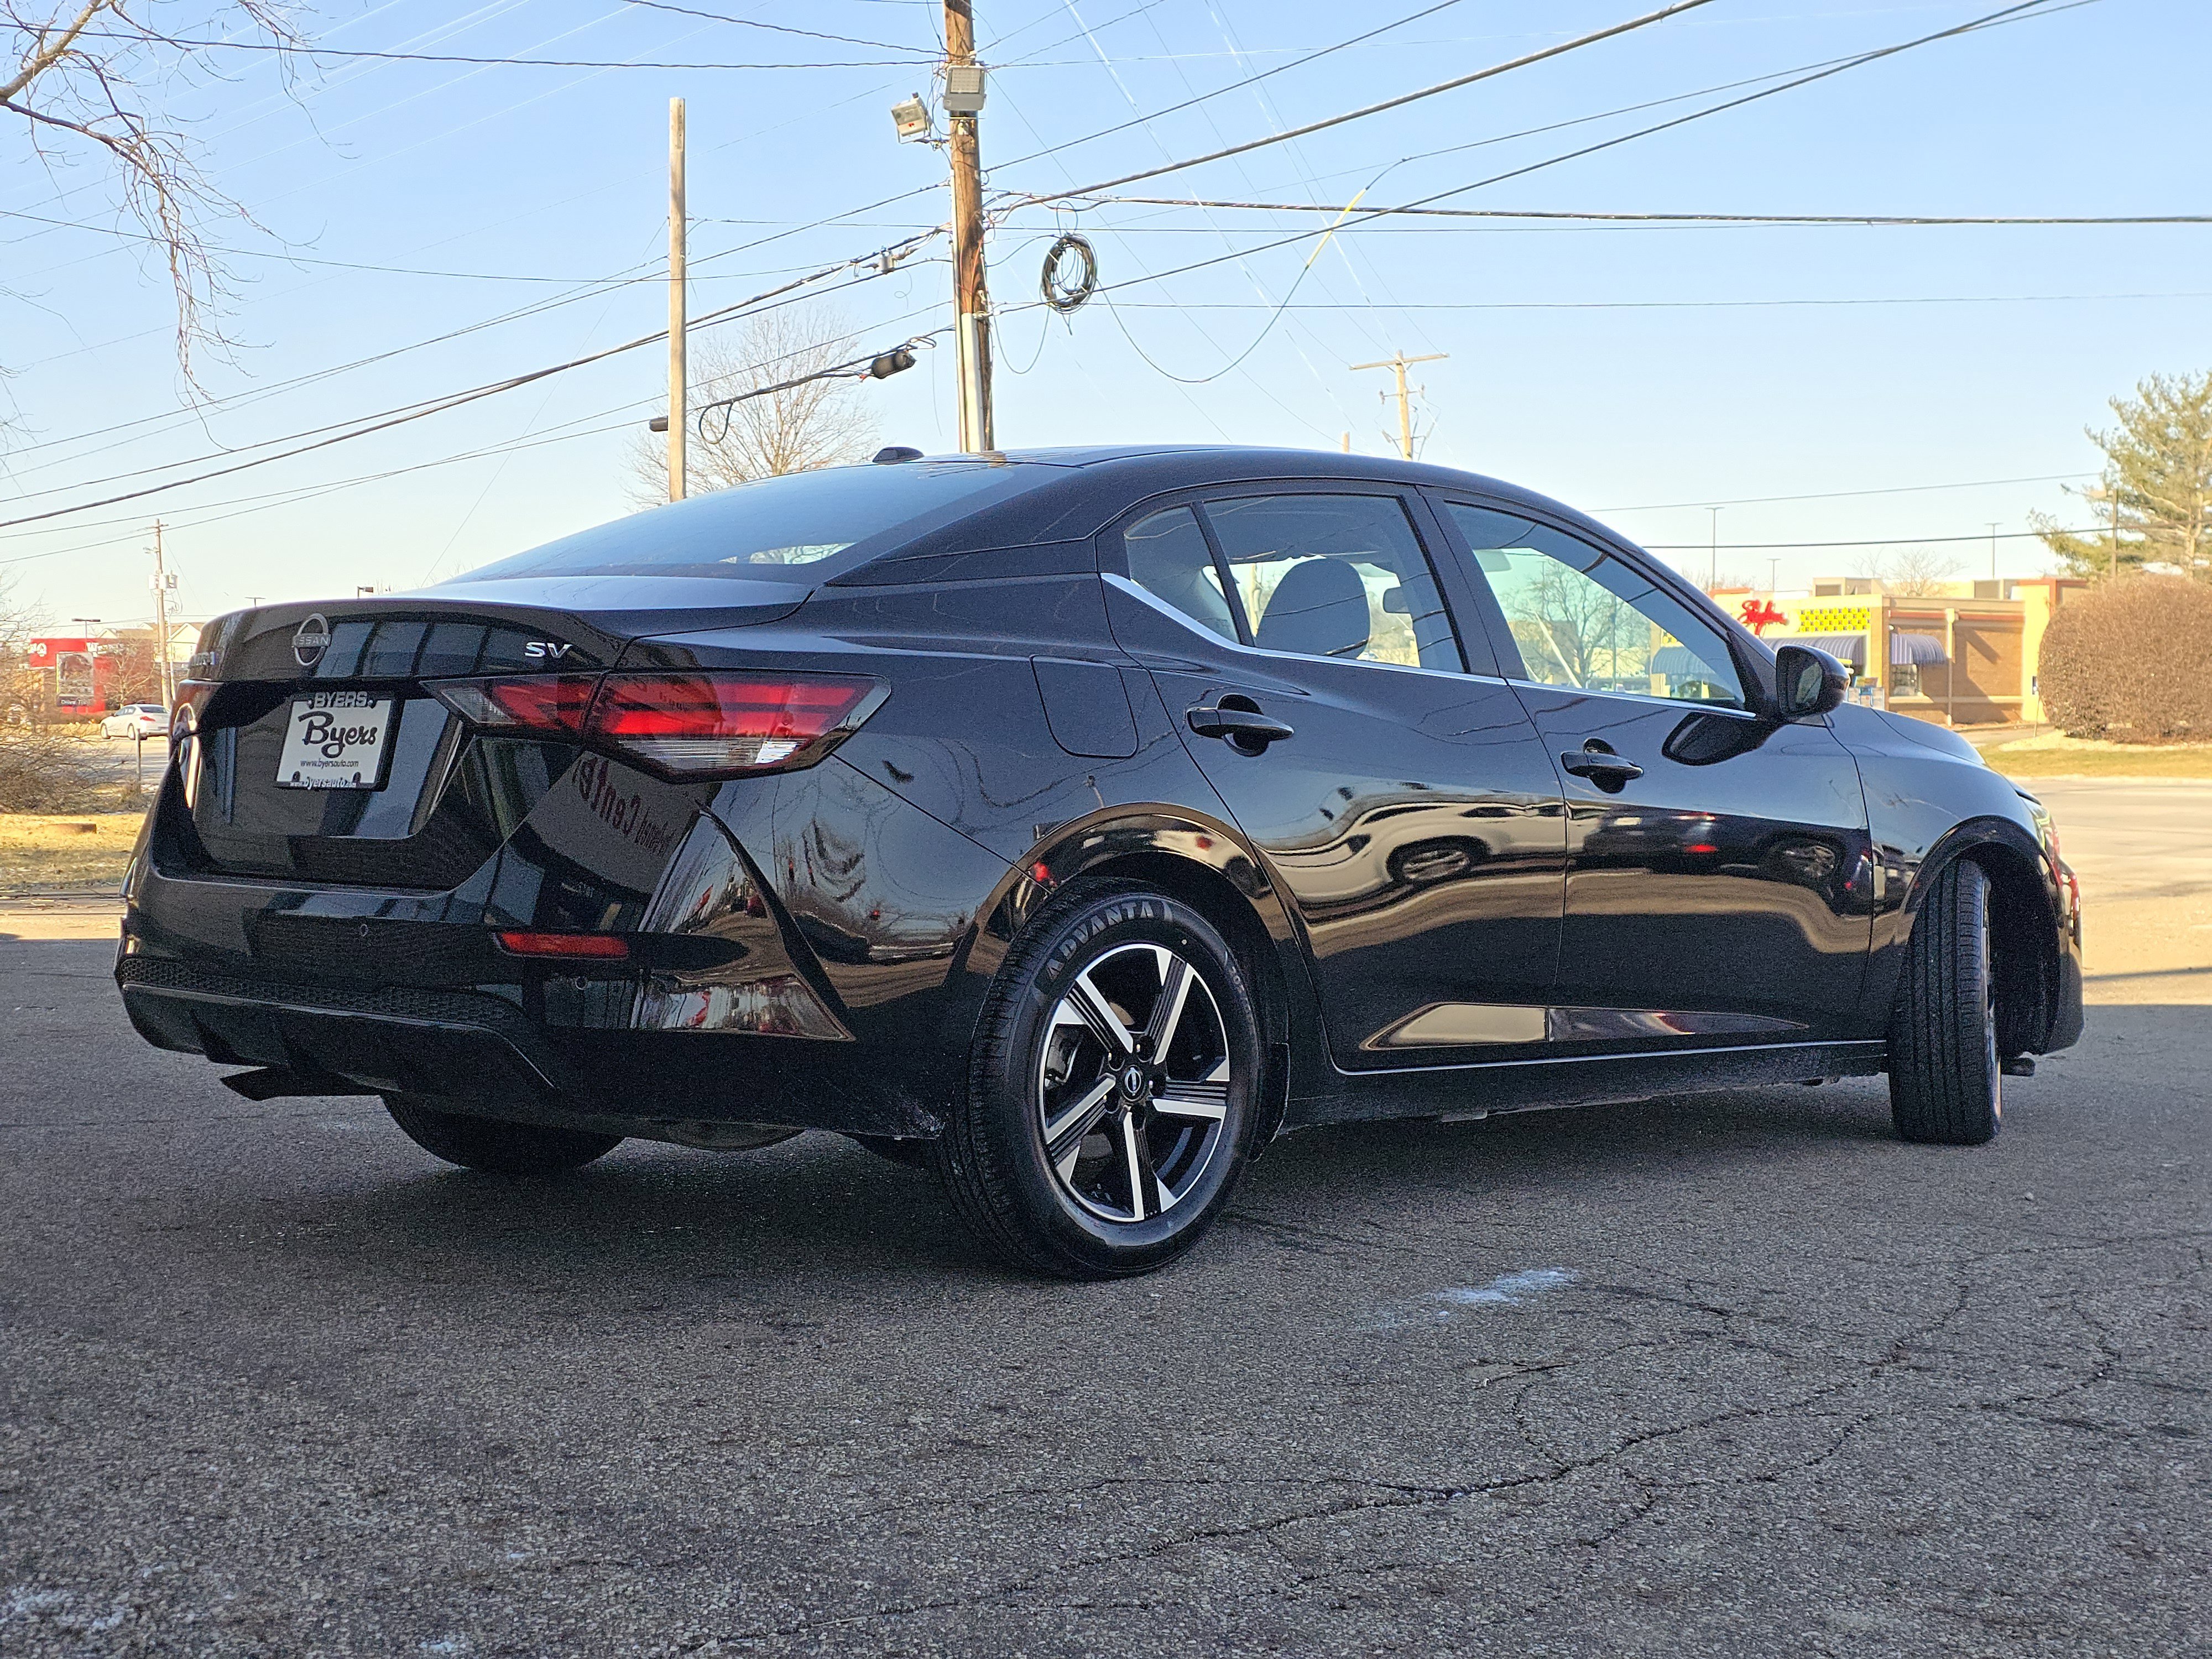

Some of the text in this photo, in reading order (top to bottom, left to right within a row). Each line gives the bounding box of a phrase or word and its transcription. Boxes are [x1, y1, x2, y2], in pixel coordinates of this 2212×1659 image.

[292, 635, 330, 645] SSAN
[524, 641, 573, 659] SV
[314, 691, 369, 708] BYERS
[297, 710, 378, 759] Byers
[300, 758, 359, 769] www.byersauto.com
[1046, 900, 1155, 980] ADVANTA
